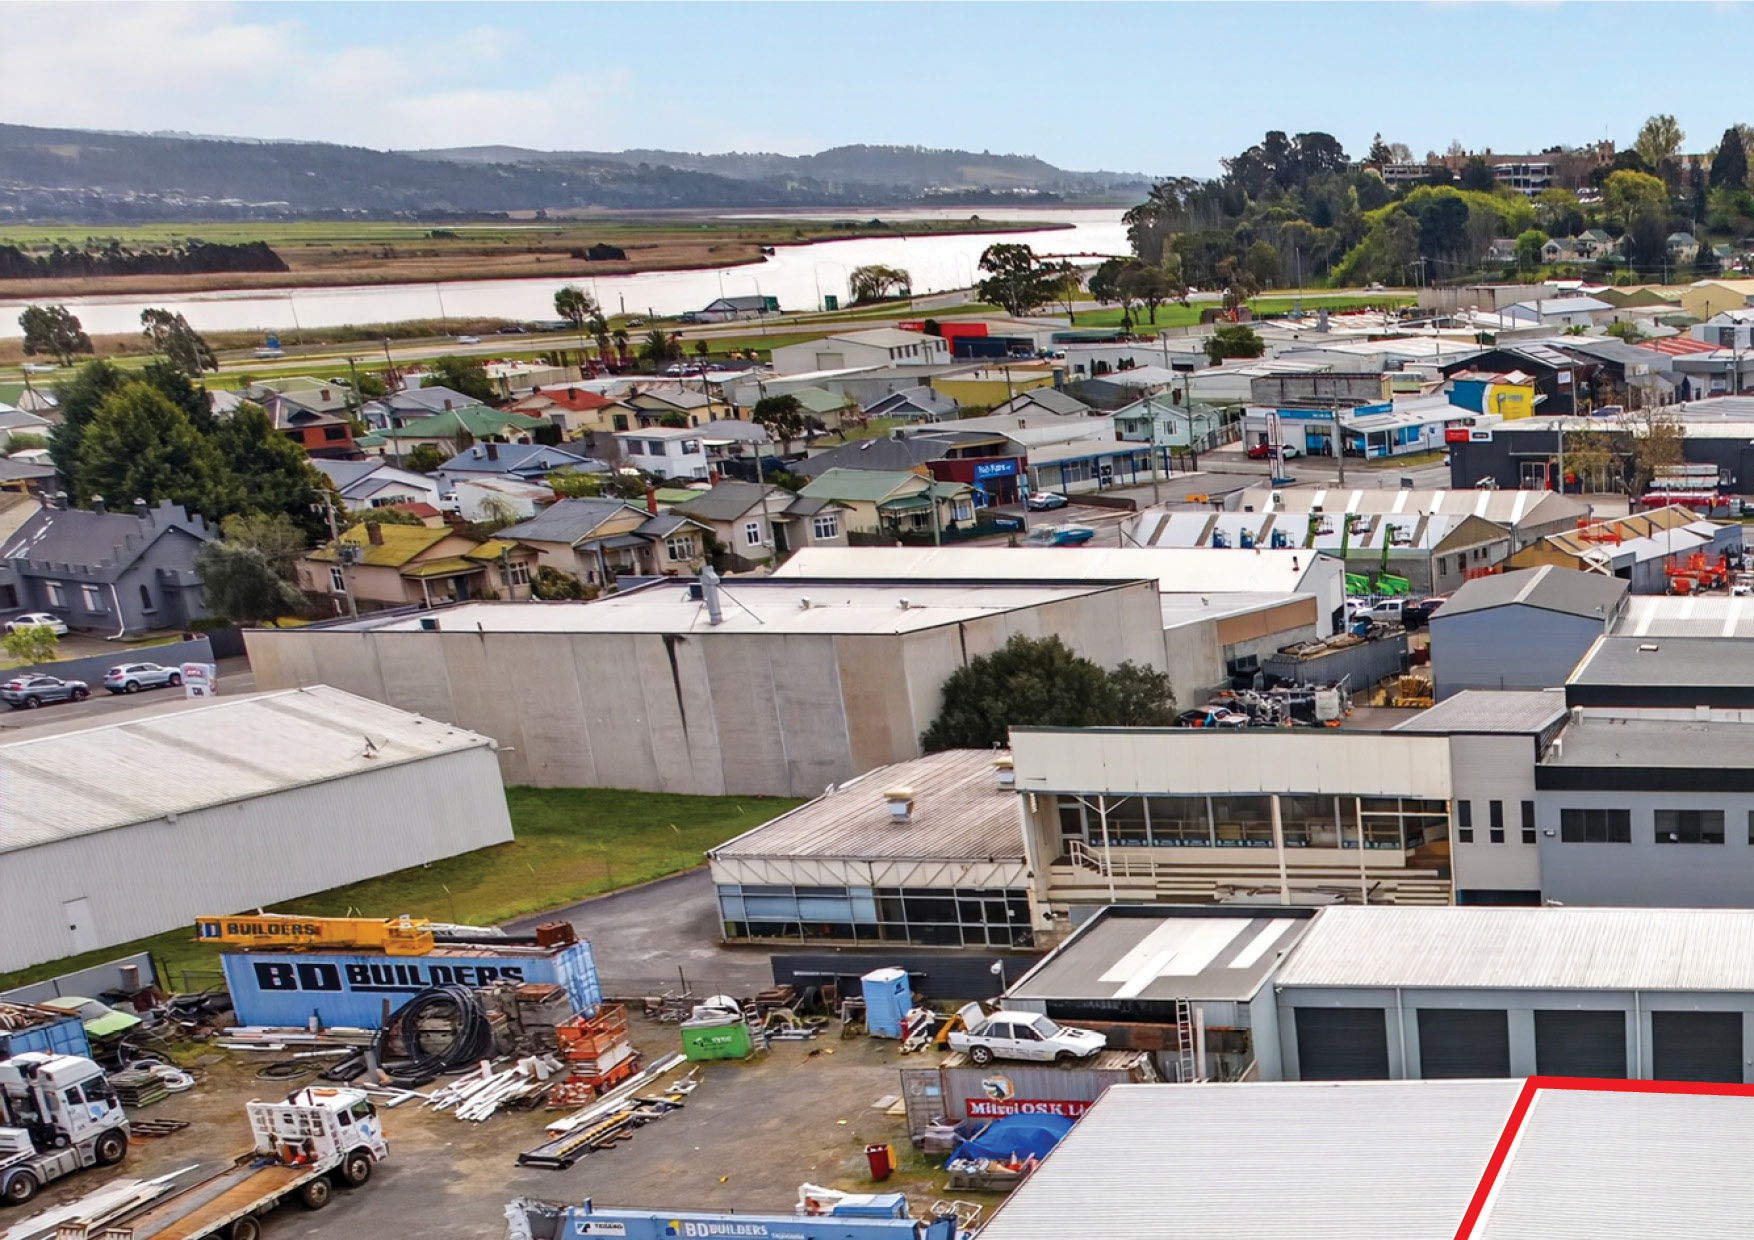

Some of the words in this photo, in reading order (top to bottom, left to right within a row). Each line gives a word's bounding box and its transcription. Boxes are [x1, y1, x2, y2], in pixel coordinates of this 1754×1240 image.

[226, 922, 315, 936] BUILDERS
[253, 962, 342, 992] BD
[345, 963, 525, 987] BUILDERS
[685, 1222, 709, 1237] BD
[709, 1223, 769, 1236] BUILDERS
